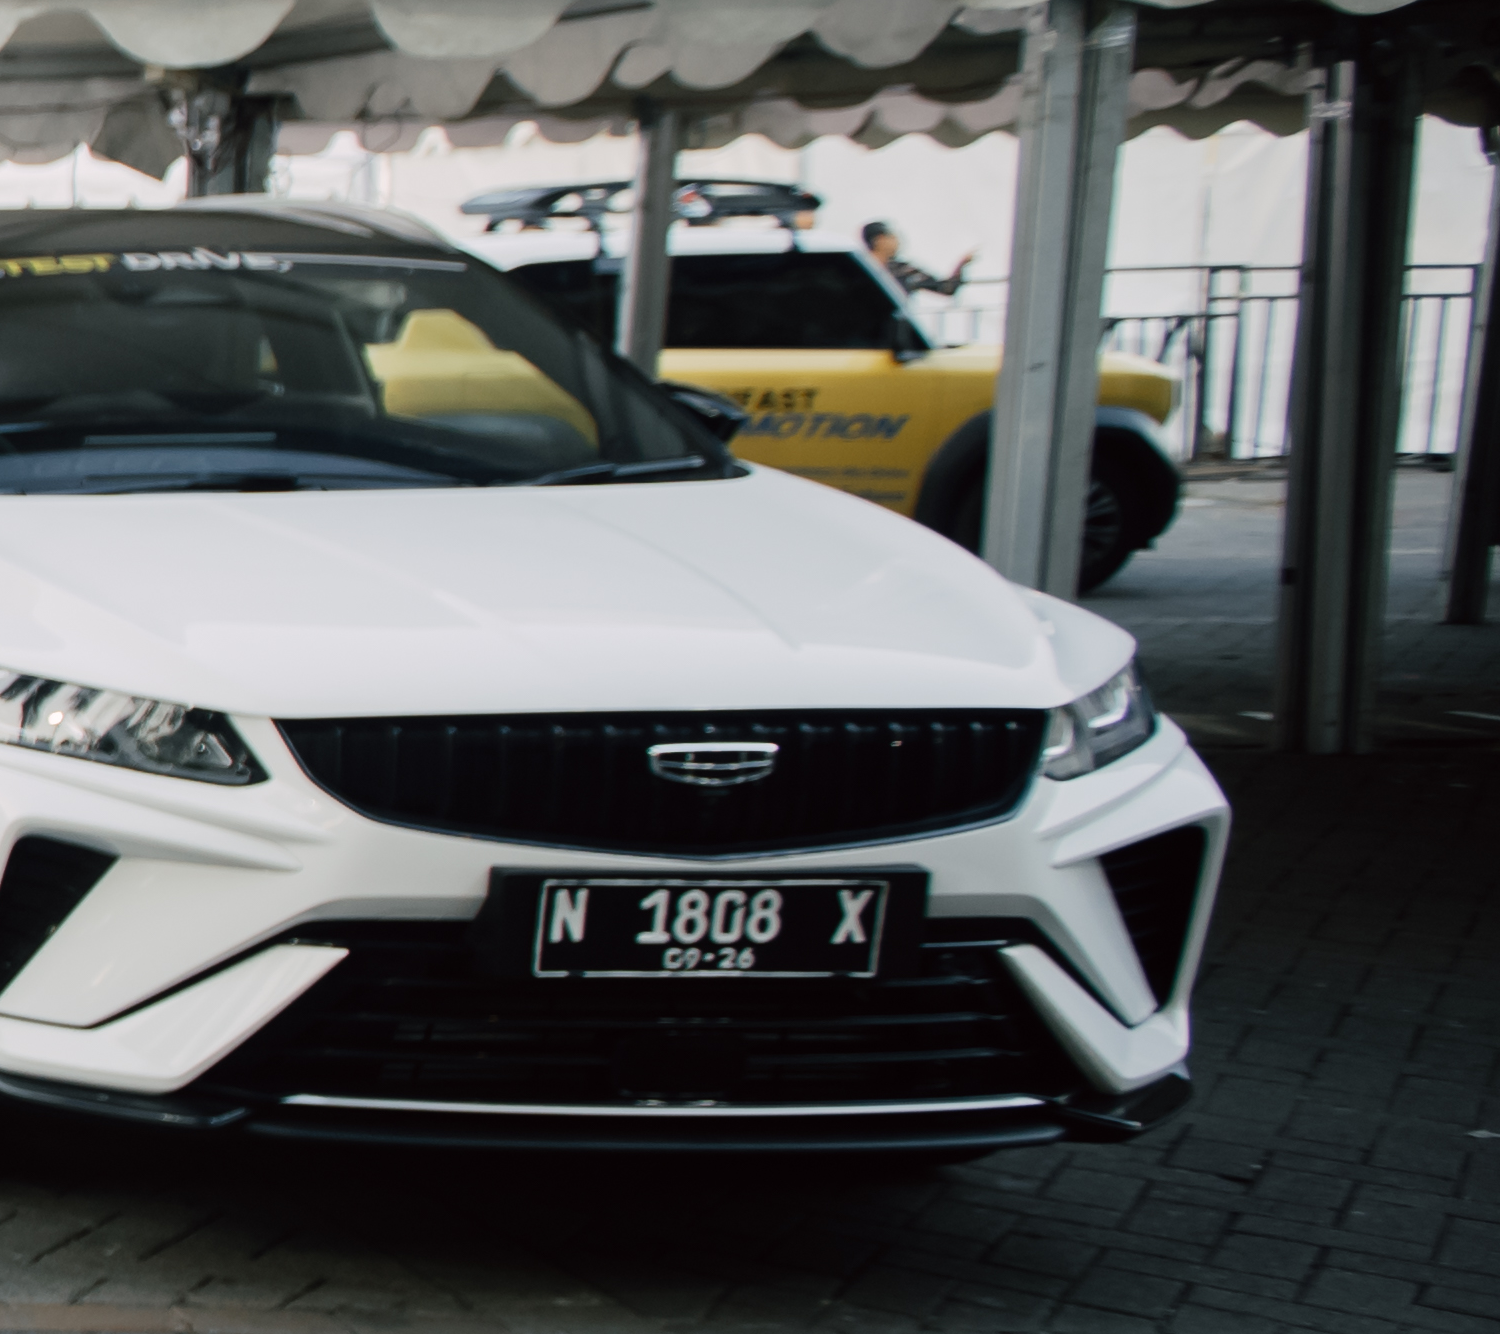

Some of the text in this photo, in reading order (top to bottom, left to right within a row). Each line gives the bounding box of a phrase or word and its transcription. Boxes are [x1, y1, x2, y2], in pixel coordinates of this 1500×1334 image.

[121, 247, 280, 271] DRIVE
[549, 888, 874, 944] N 1808 X
